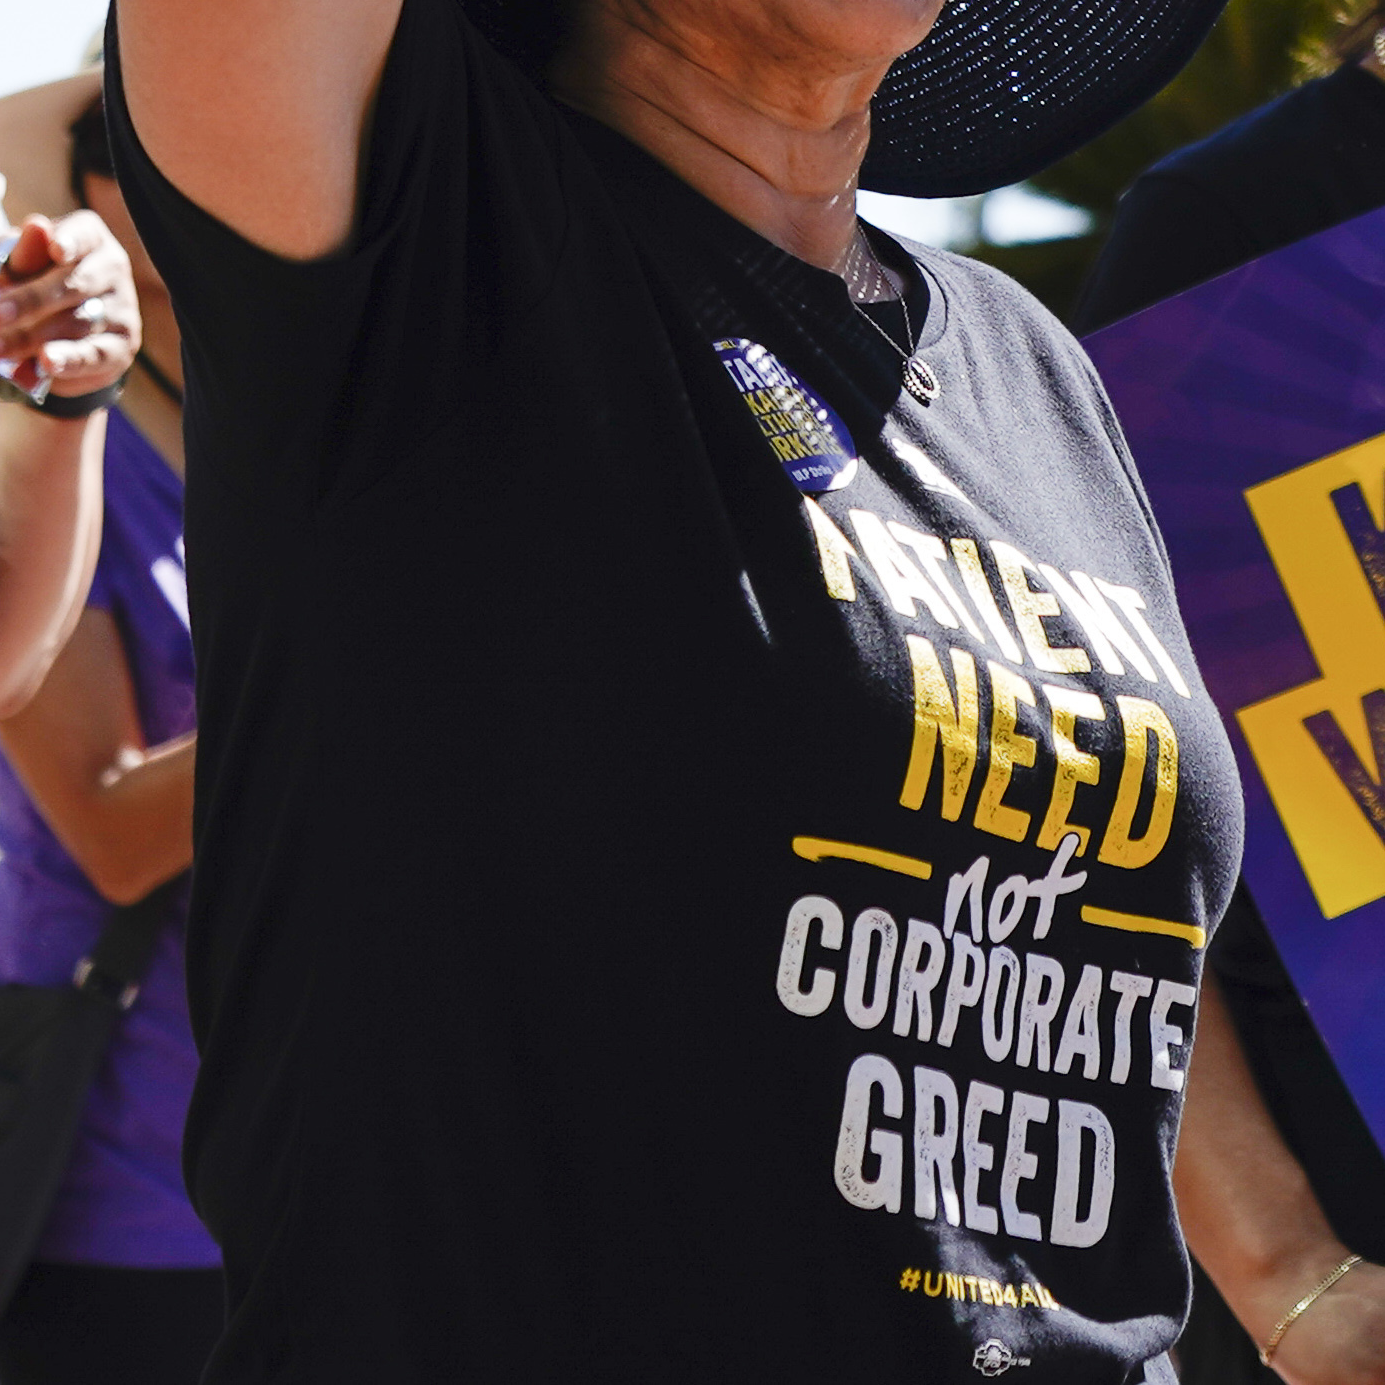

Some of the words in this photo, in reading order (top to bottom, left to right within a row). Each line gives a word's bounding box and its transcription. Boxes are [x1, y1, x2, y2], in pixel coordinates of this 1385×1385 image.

[899, 634, 1179, 869] NEED
[944, 831, 1088, 943] not
[776, 895, 1196, 1092] CORPORATE
[833, 1054, 1115, 1249] GREED
[899, 1267, 1061, 1312] #UNITED4ALL
